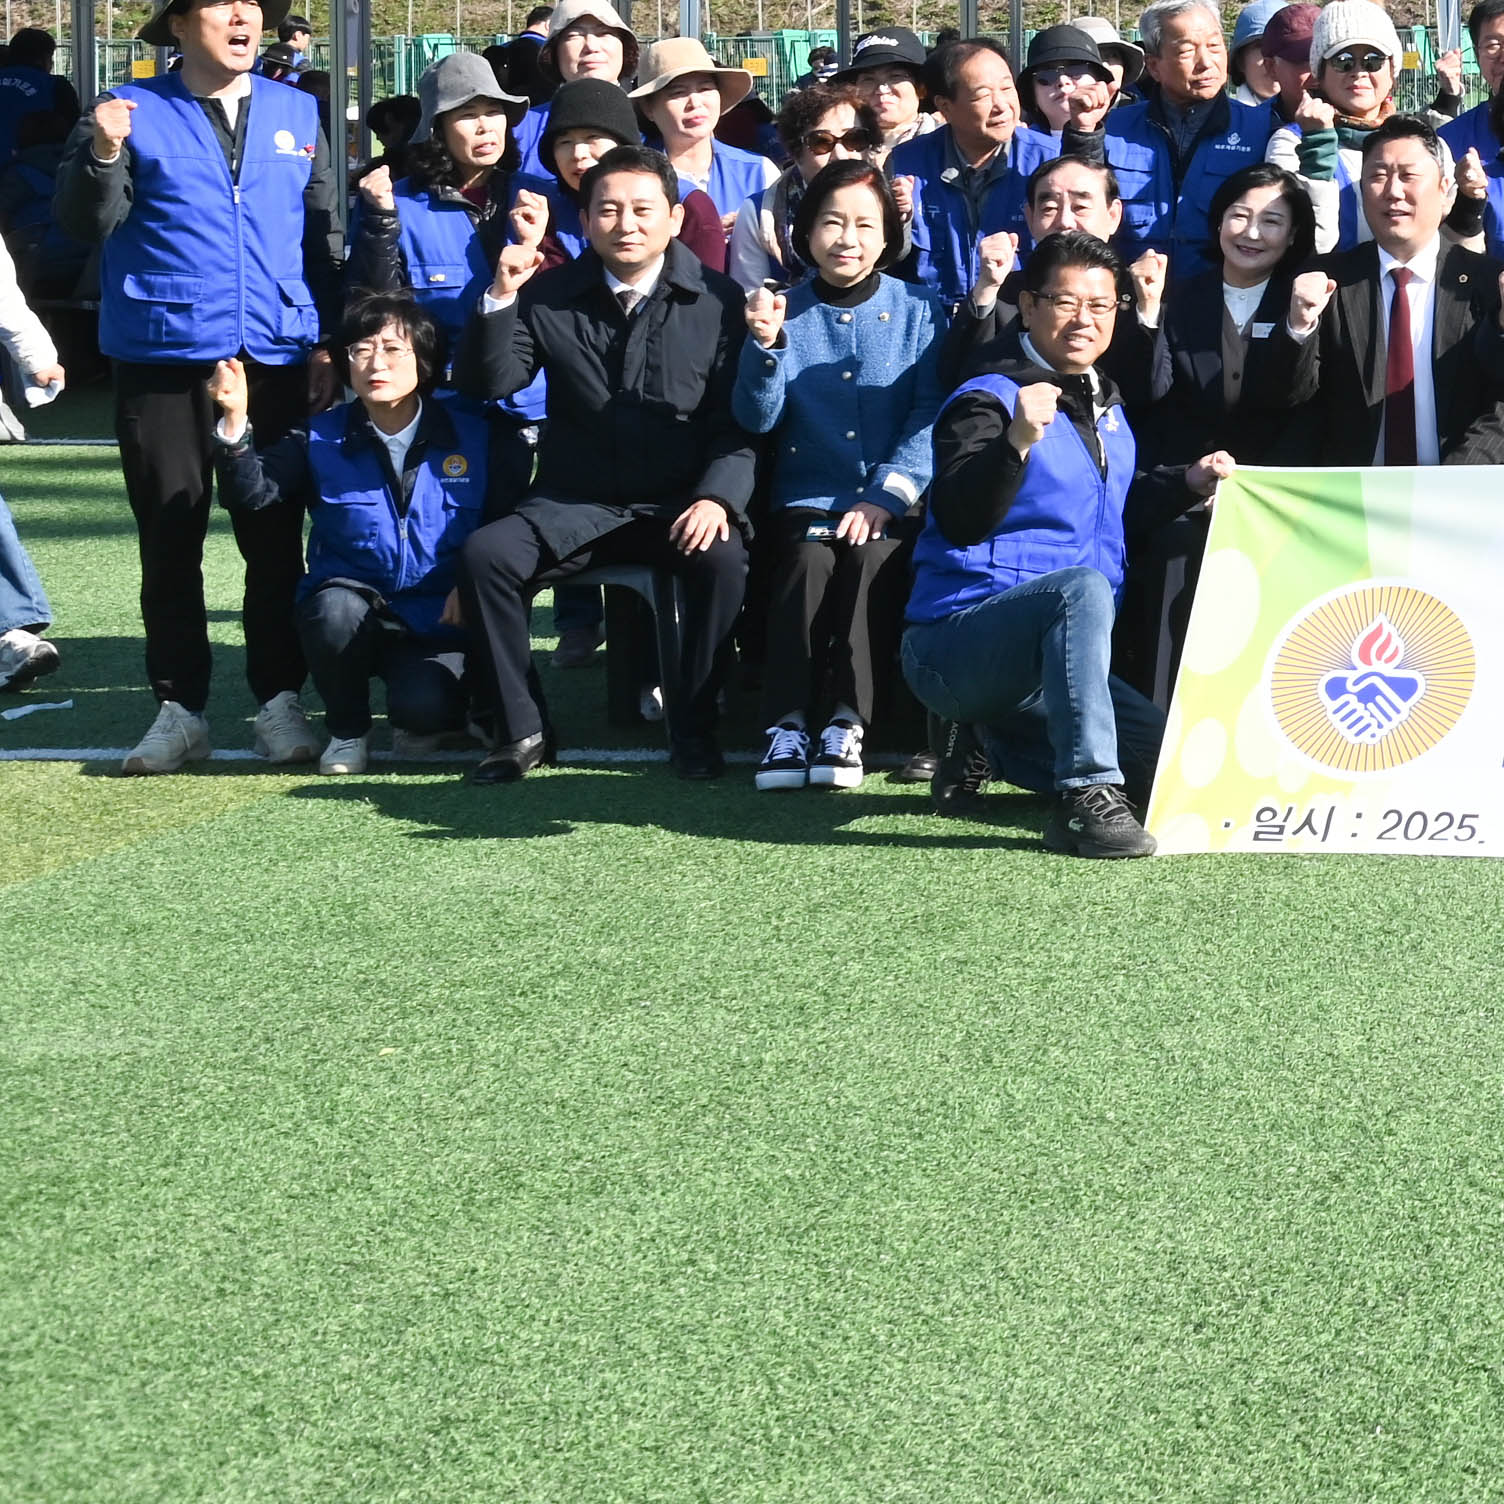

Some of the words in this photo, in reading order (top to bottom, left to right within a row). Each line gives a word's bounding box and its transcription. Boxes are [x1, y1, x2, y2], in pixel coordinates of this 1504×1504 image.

[945, 720, 960, 758] ACOSTE
[1252, 805, 1336, 843] 일시
[1376, 809, 1485, 844] 2025.
